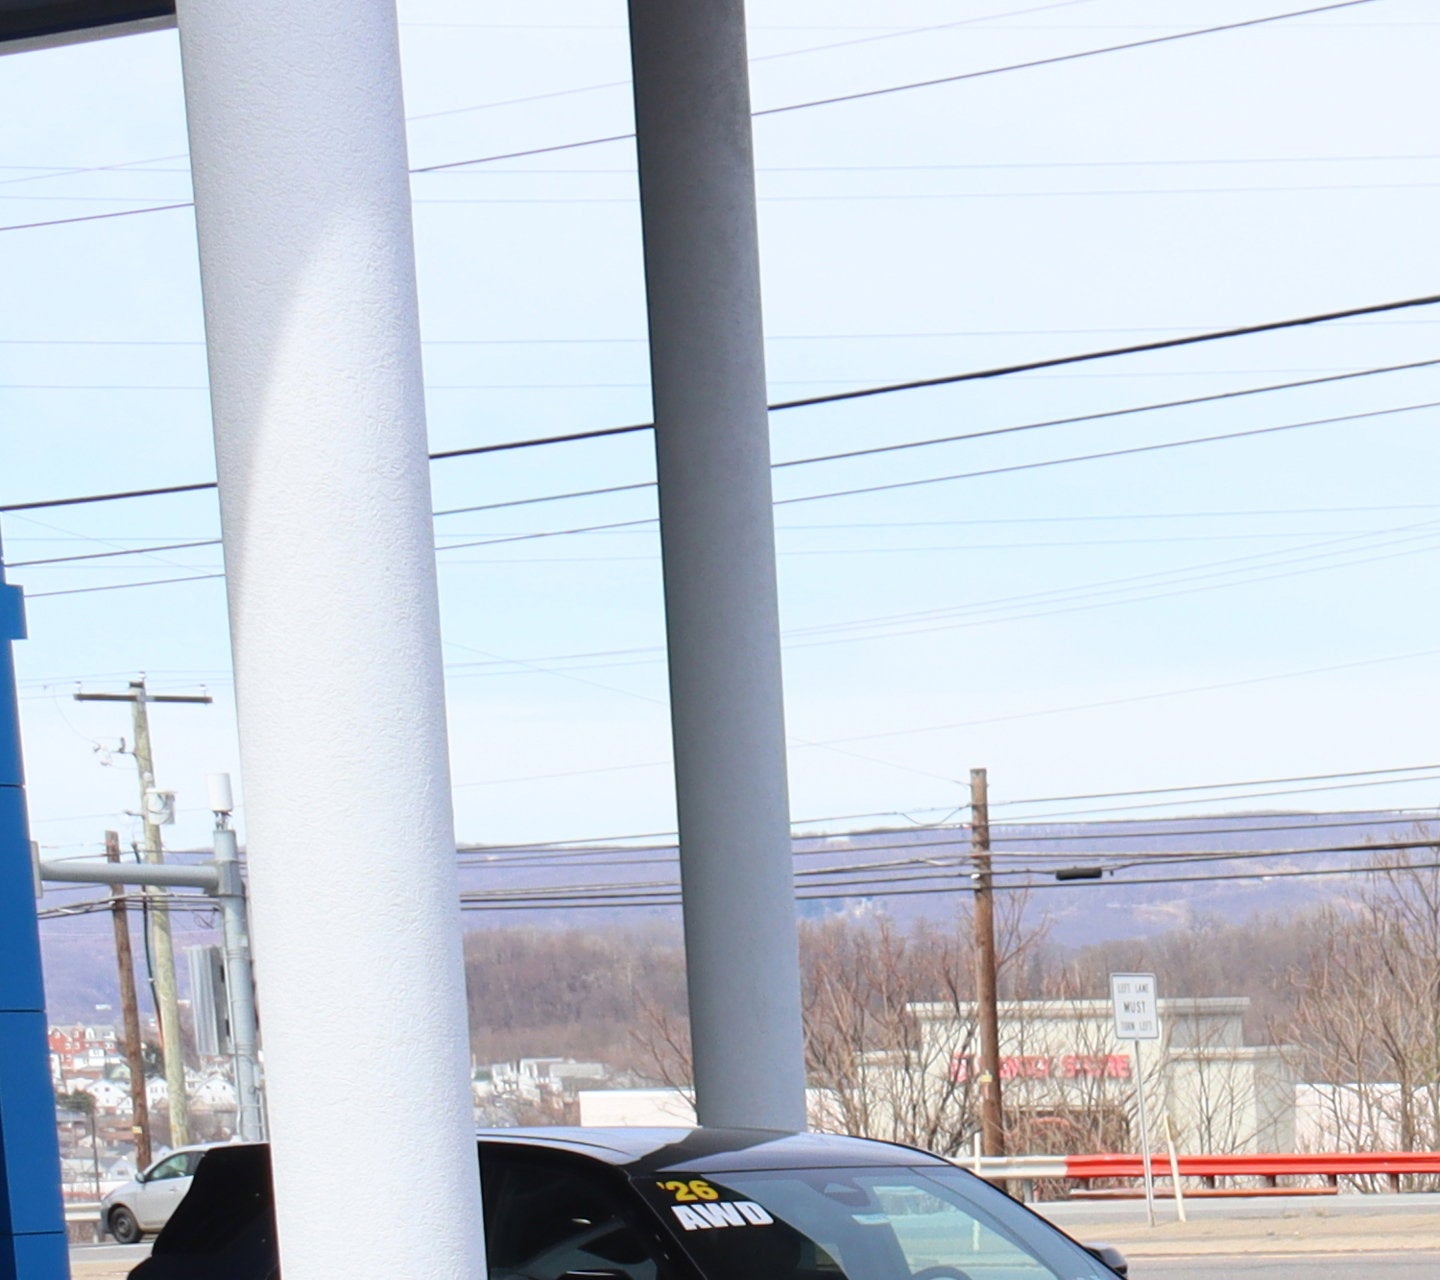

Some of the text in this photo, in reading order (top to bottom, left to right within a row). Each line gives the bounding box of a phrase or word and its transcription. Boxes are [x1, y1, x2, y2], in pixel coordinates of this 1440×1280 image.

[1123, 1000, 1146, 1013] MUST
[656, 1180, 719, 1201] '26
[671, 1201, 774, 1231] AWD
